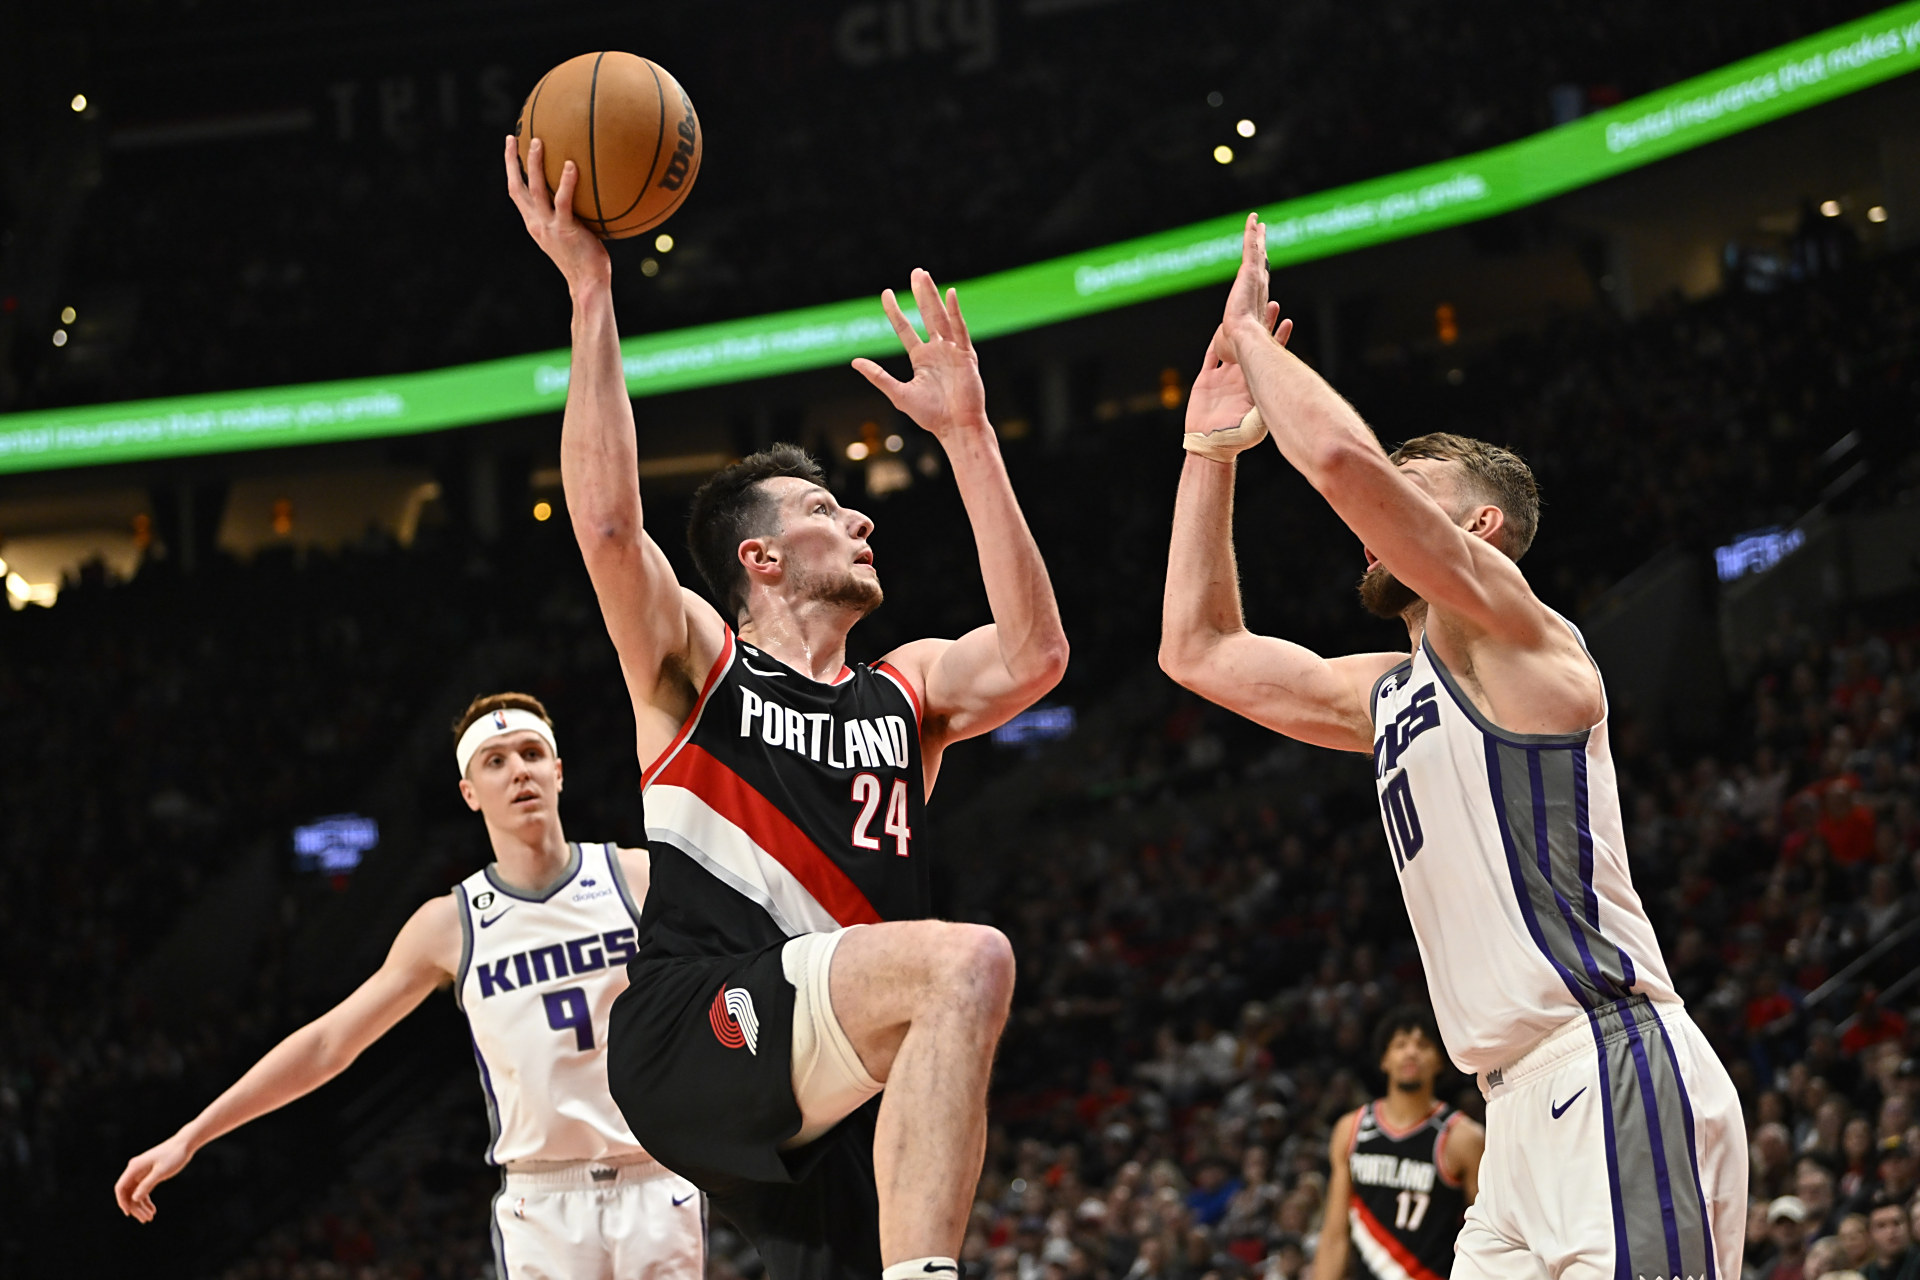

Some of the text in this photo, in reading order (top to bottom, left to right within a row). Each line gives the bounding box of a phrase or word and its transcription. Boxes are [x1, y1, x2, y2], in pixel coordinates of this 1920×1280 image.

[739, 685, 909, 769] PORTLAND
[852, 772, 911, 857] 24
[1381, 768, 1423, 872] 10
[476, 927, 637, 999] KINGS
[541, 987, 595, 1052] 9
[1351, 1153, 1436, 1192] PORTLAND
[1395, 1191, 1430, 1231] 17
